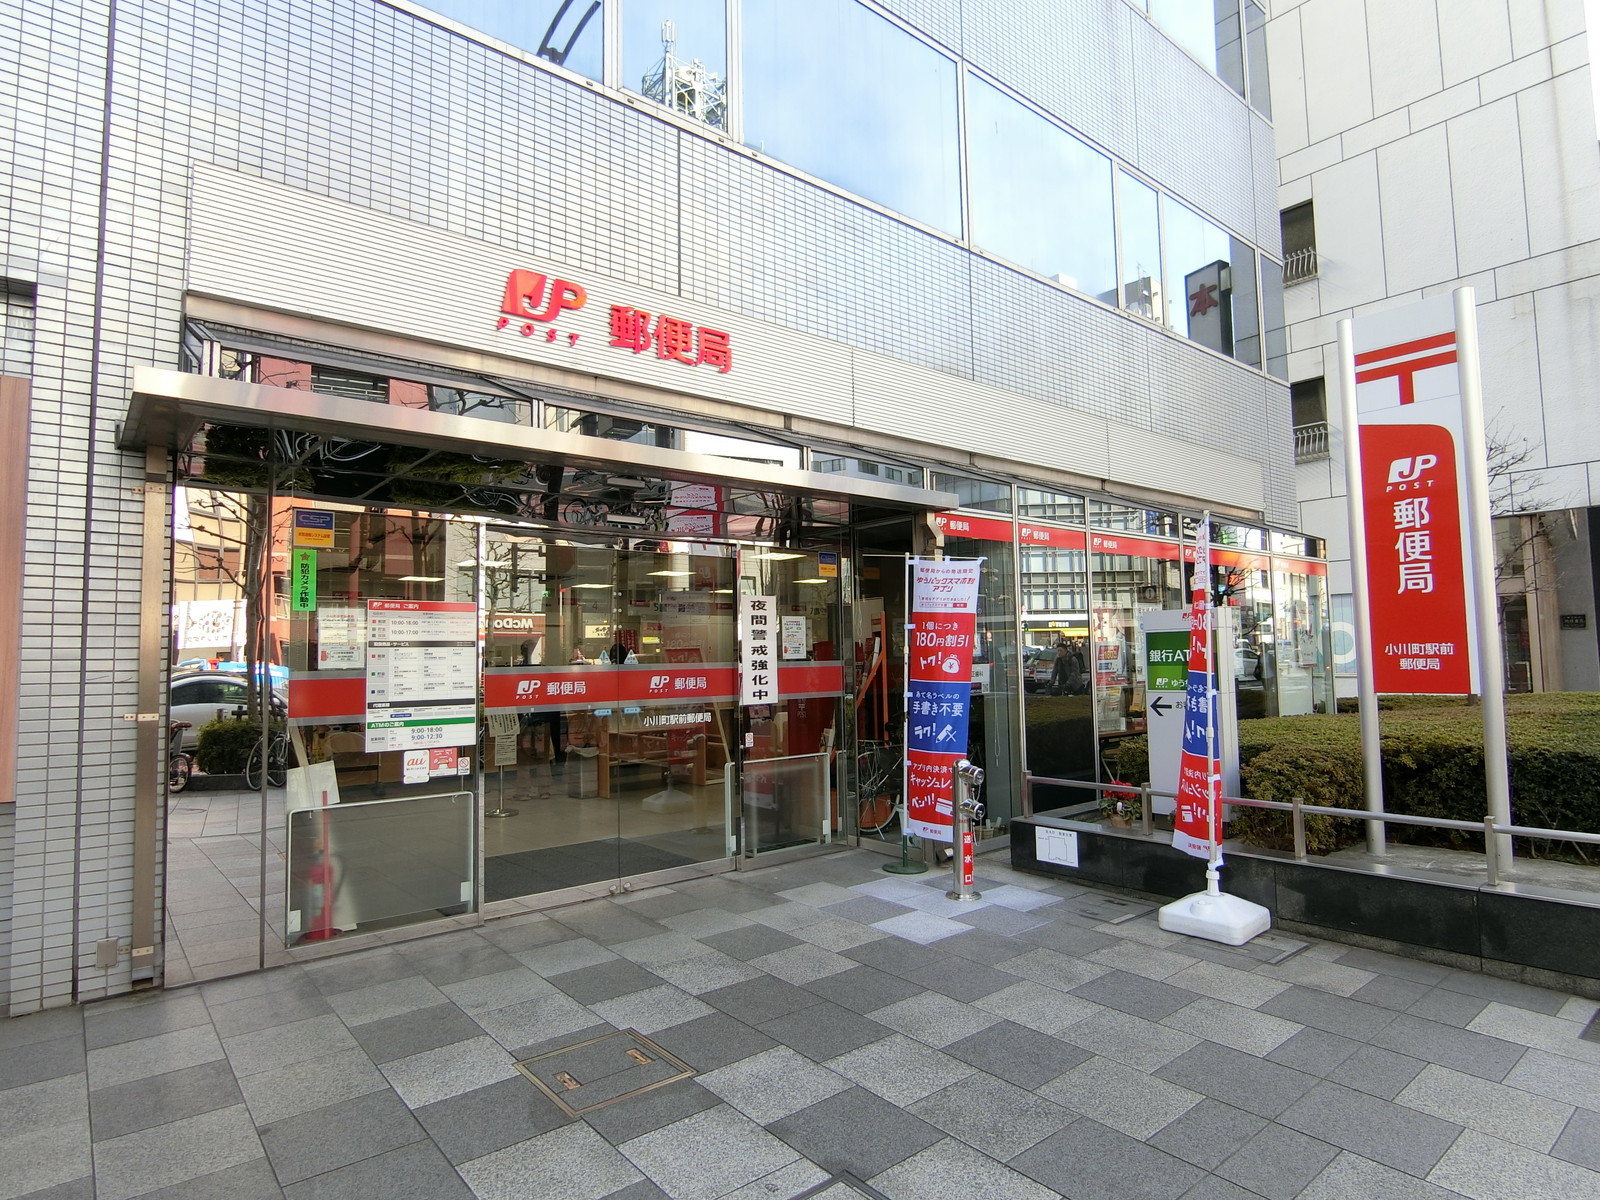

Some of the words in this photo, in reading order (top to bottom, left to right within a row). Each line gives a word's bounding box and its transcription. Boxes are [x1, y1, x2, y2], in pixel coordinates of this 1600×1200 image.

[502, 269, 587, 322] JP
[497, 316, 580, 347] POST
[609, 304, 733, 374] 郵便局
[1388, 454, 1437, 484] JP
[1386, 480, 1434, 492] POST
[299, 514, 331, 524] CSP
[950, 520, 970, 532] 郵便局
[1033, 530, 1050, 541] 郵便局
[1393, 497, 1434, 594] 郵便局
[300, 563, 310, 608] 防犯カメラ作動中
[922, 622, 959, 630] 1個につき
[916, 632, 970, 648] 180円割引
[750, 600, 768, 700] 夜間警戒強化中
[1149, 650, 1190, 662] 銀行AT
[1384, 643, 1454, 656] 小川町駅前
[1400, 658, 1440, 670] 郵便局
[546, 681, 586, 696] 郵便局
[674, 677, 707, 690] 郵便局
[916, 690, 960, 700] あて名ラベルの
[912, 700, 964, 717] 手書き不要
[644, 712, 712, 726] 小川町駅前郵便局
[407, 758, 426, 766] au
